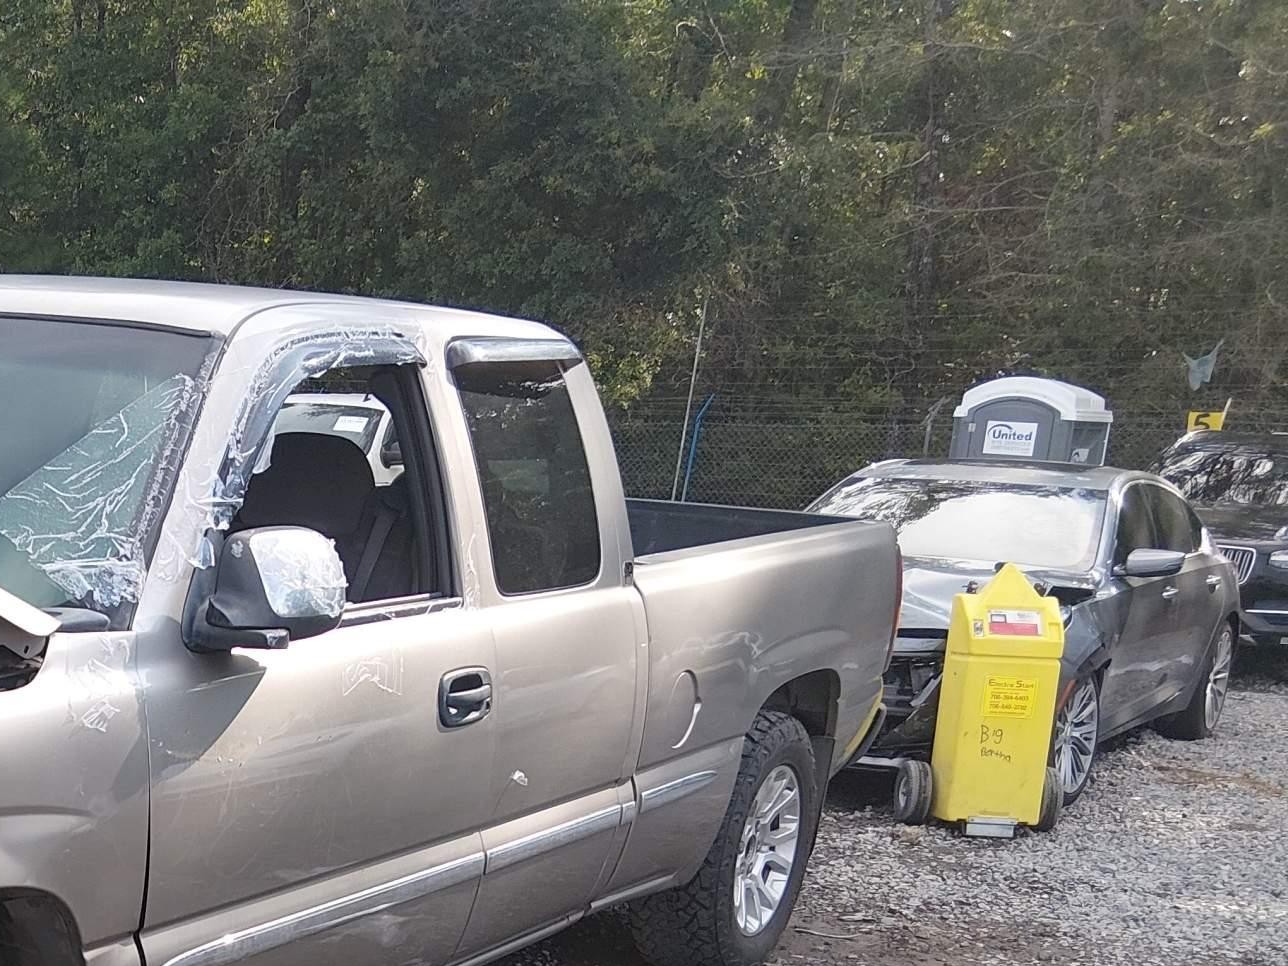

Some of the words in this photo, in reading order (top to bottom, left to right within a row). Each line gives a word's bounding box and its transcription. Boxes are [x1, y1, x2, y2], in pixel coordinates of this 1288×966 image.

[1194, 413, 1210, 430] 5
[992, 429, 1033, 441] United
[980, 724, 1004, 745] Big
